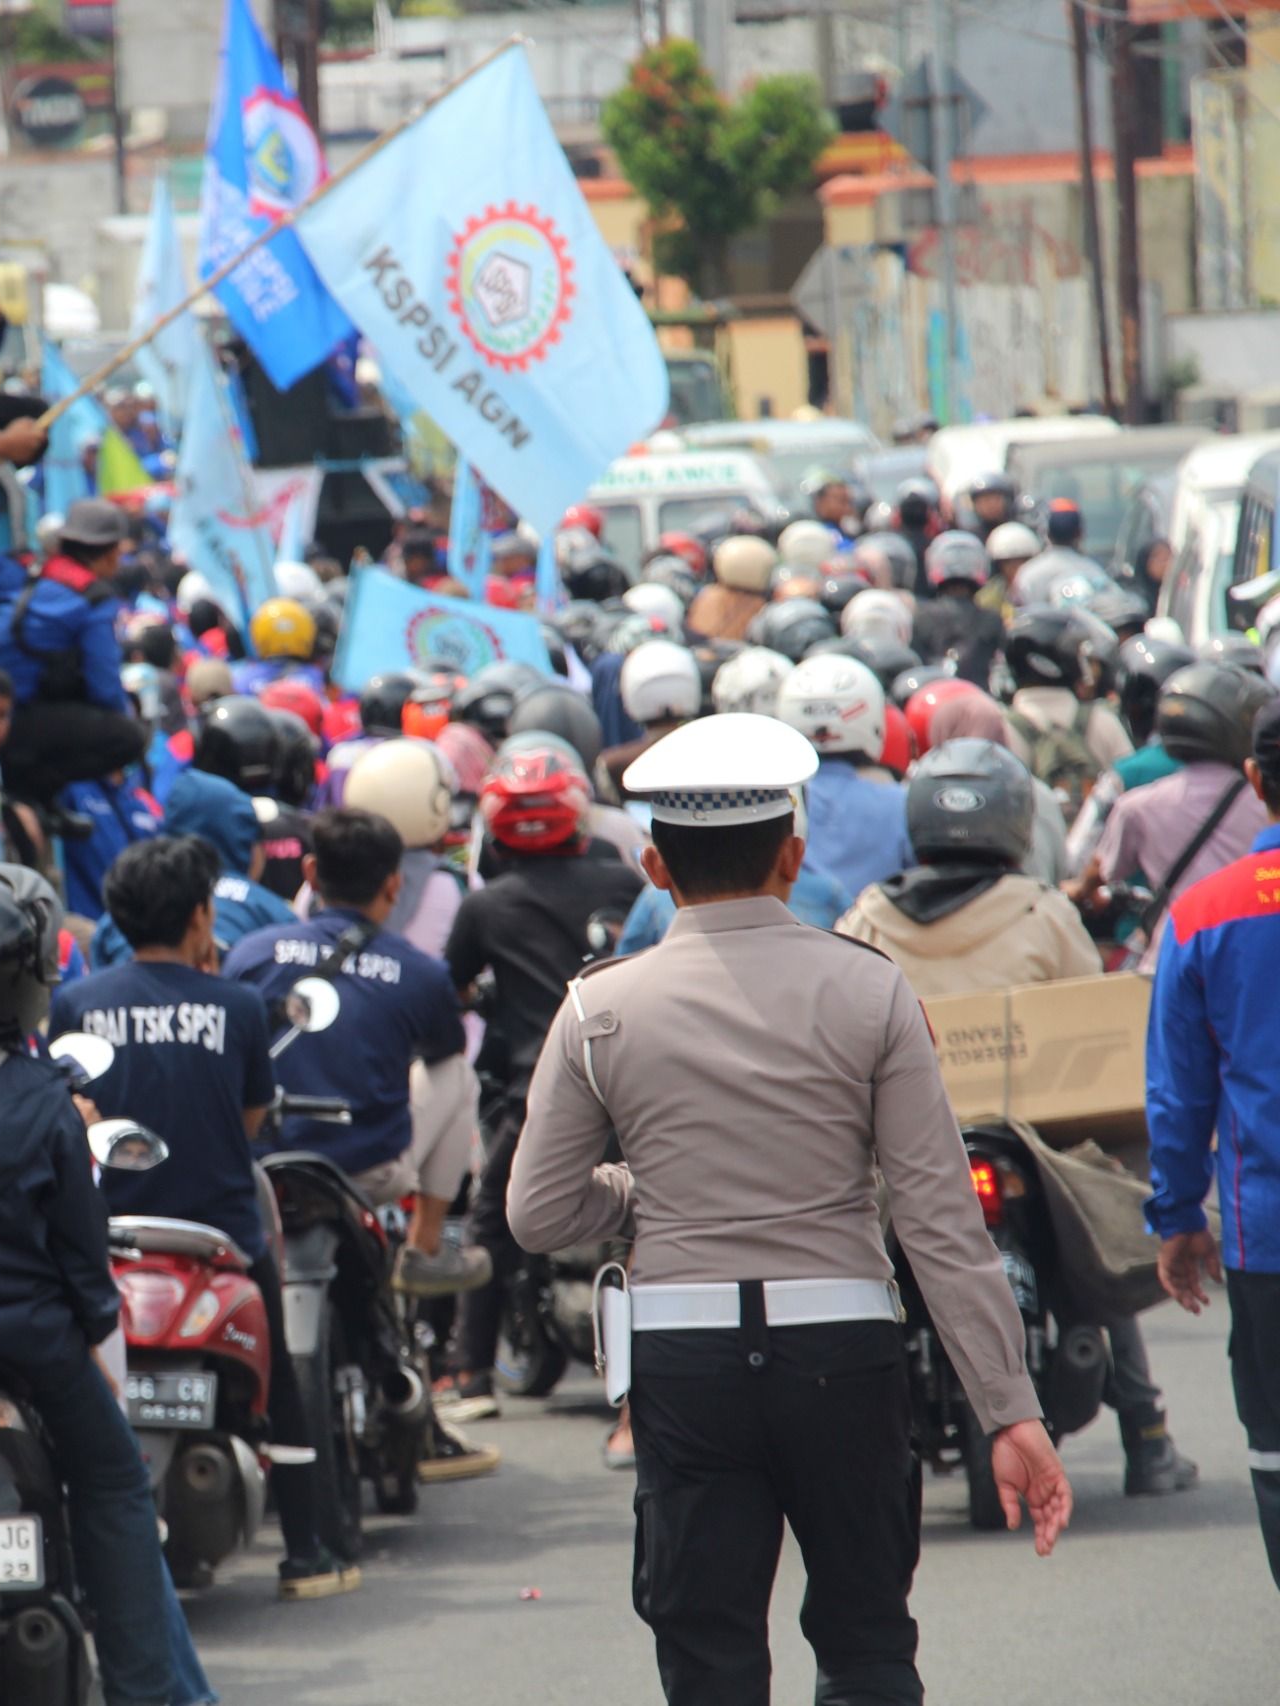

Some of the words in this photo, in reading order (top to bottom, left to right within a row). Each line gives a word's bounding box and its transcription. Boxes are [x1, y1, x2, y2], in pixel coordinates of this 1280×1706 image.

[363, 246, 458, 373] KSPSI
[451, 368, 532, 449] AGN
[357, 952, 401, 984] SPSI
[130, 1004, 175, 1044] TSK
[177, 1002, 226, 1055] SPSI
[178, 1378, 206, 1402] CR
[1, 1526, 30, 1550] JG
